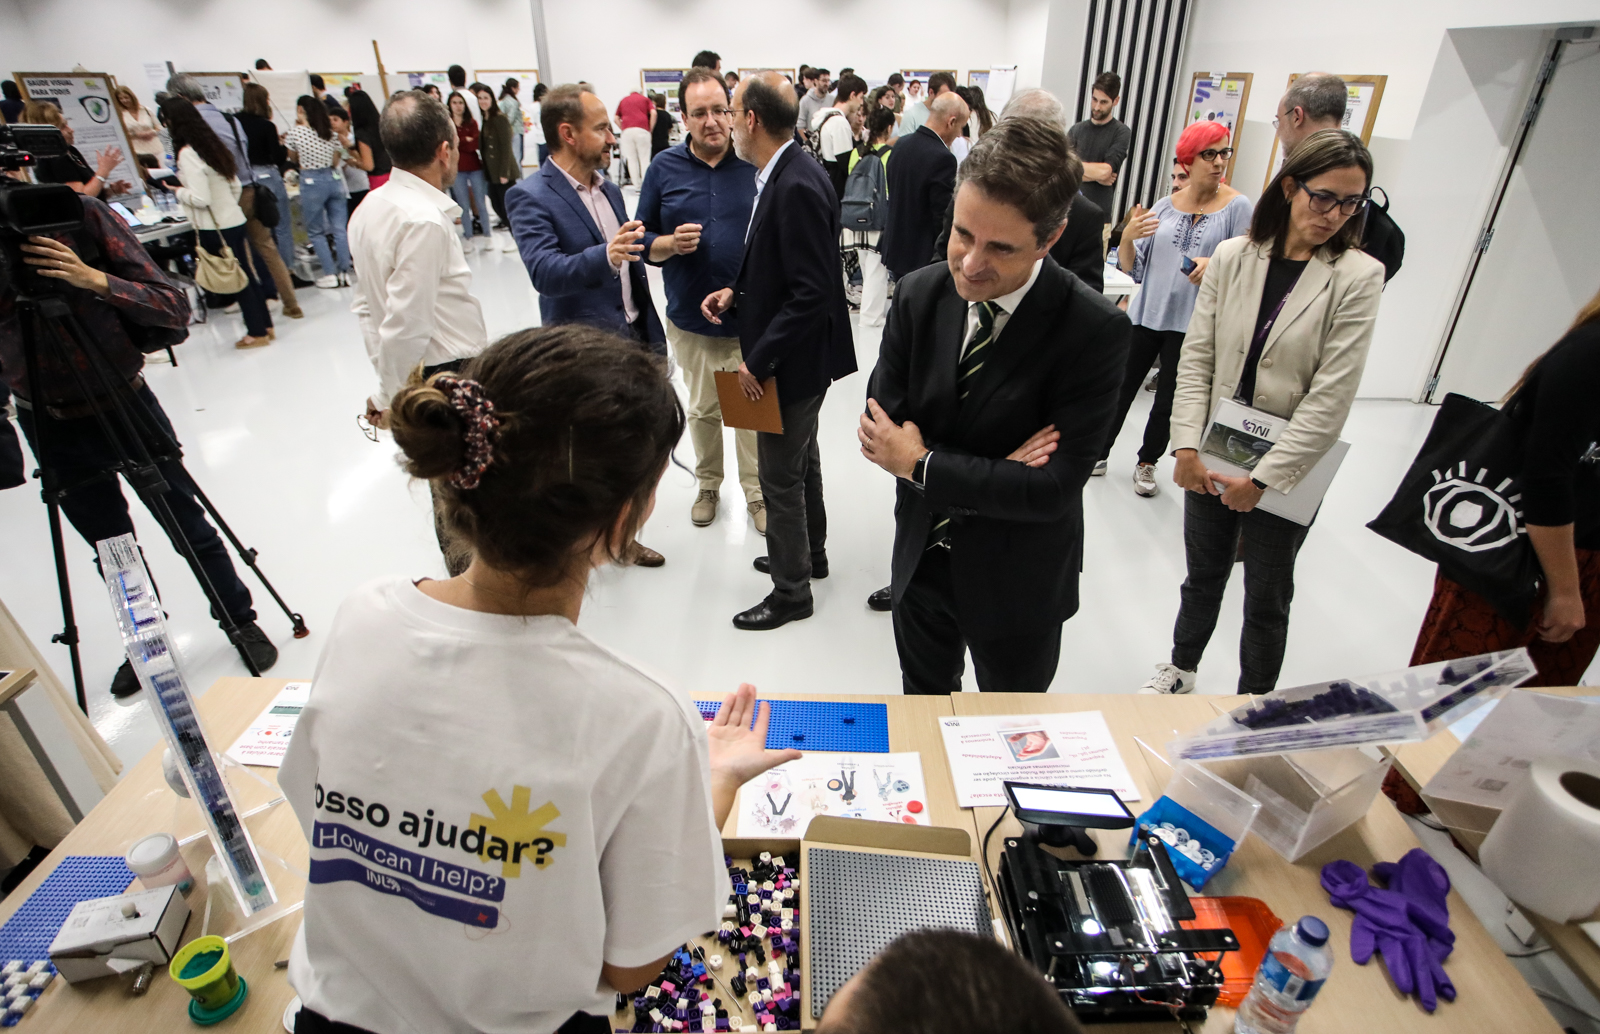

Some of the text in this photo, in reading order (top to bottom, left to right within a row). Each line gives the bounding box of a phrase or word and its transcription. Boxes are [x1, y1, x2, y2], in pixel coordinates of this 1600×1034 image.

[314, 782, 554, 865] osso ajudar?
[319, 827, 369, 856] How
[374, 844, 412, 876] can
[418, 858, 425, 877] I
[432, 861, 500, 895] help?
